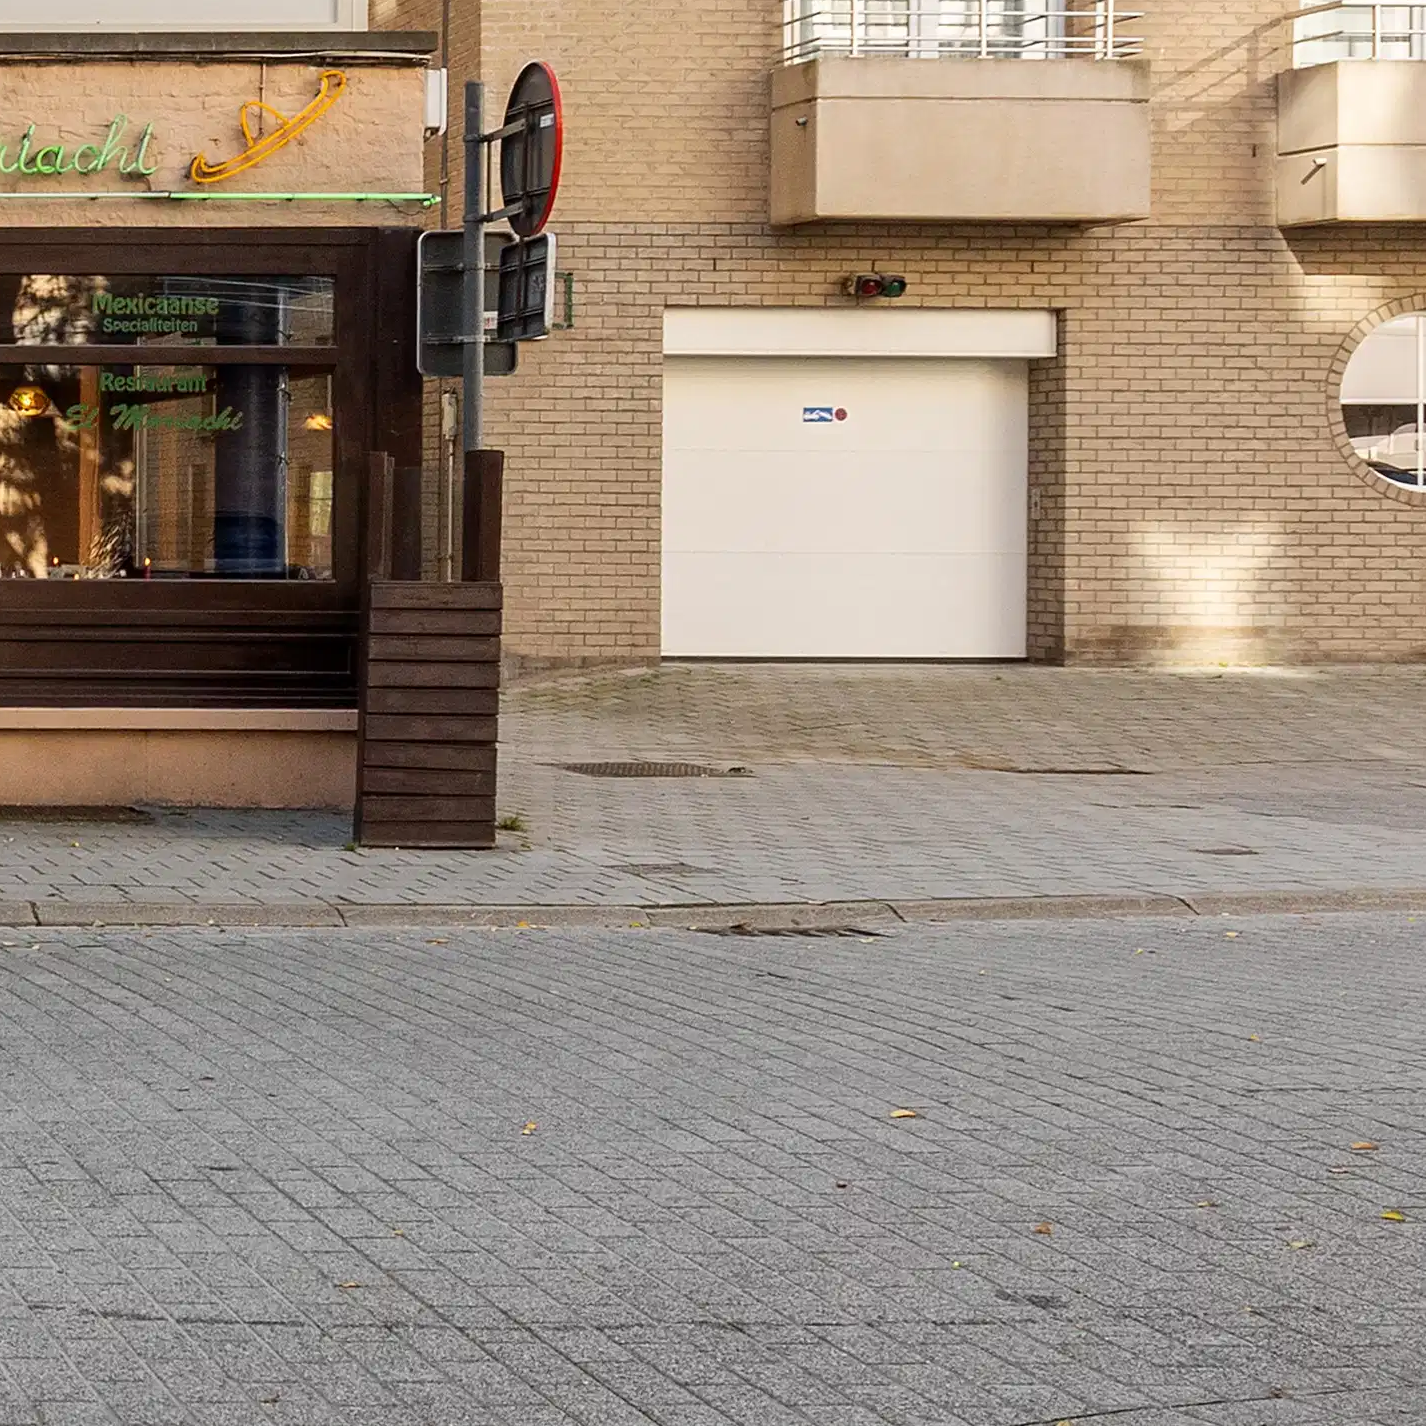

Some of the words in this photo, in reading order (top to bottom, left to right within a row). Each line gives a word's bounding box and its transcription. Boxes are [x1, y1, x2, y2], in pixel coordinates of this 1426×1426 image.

[92, 293, 220, 315] Mexicaanse
[102, 317, 198, 333] Specialiteiten
[100, 373, 208, 393] Restaurant
[65, 403, 100, 432] El
[109, 402, 244, 432] Mariachi
